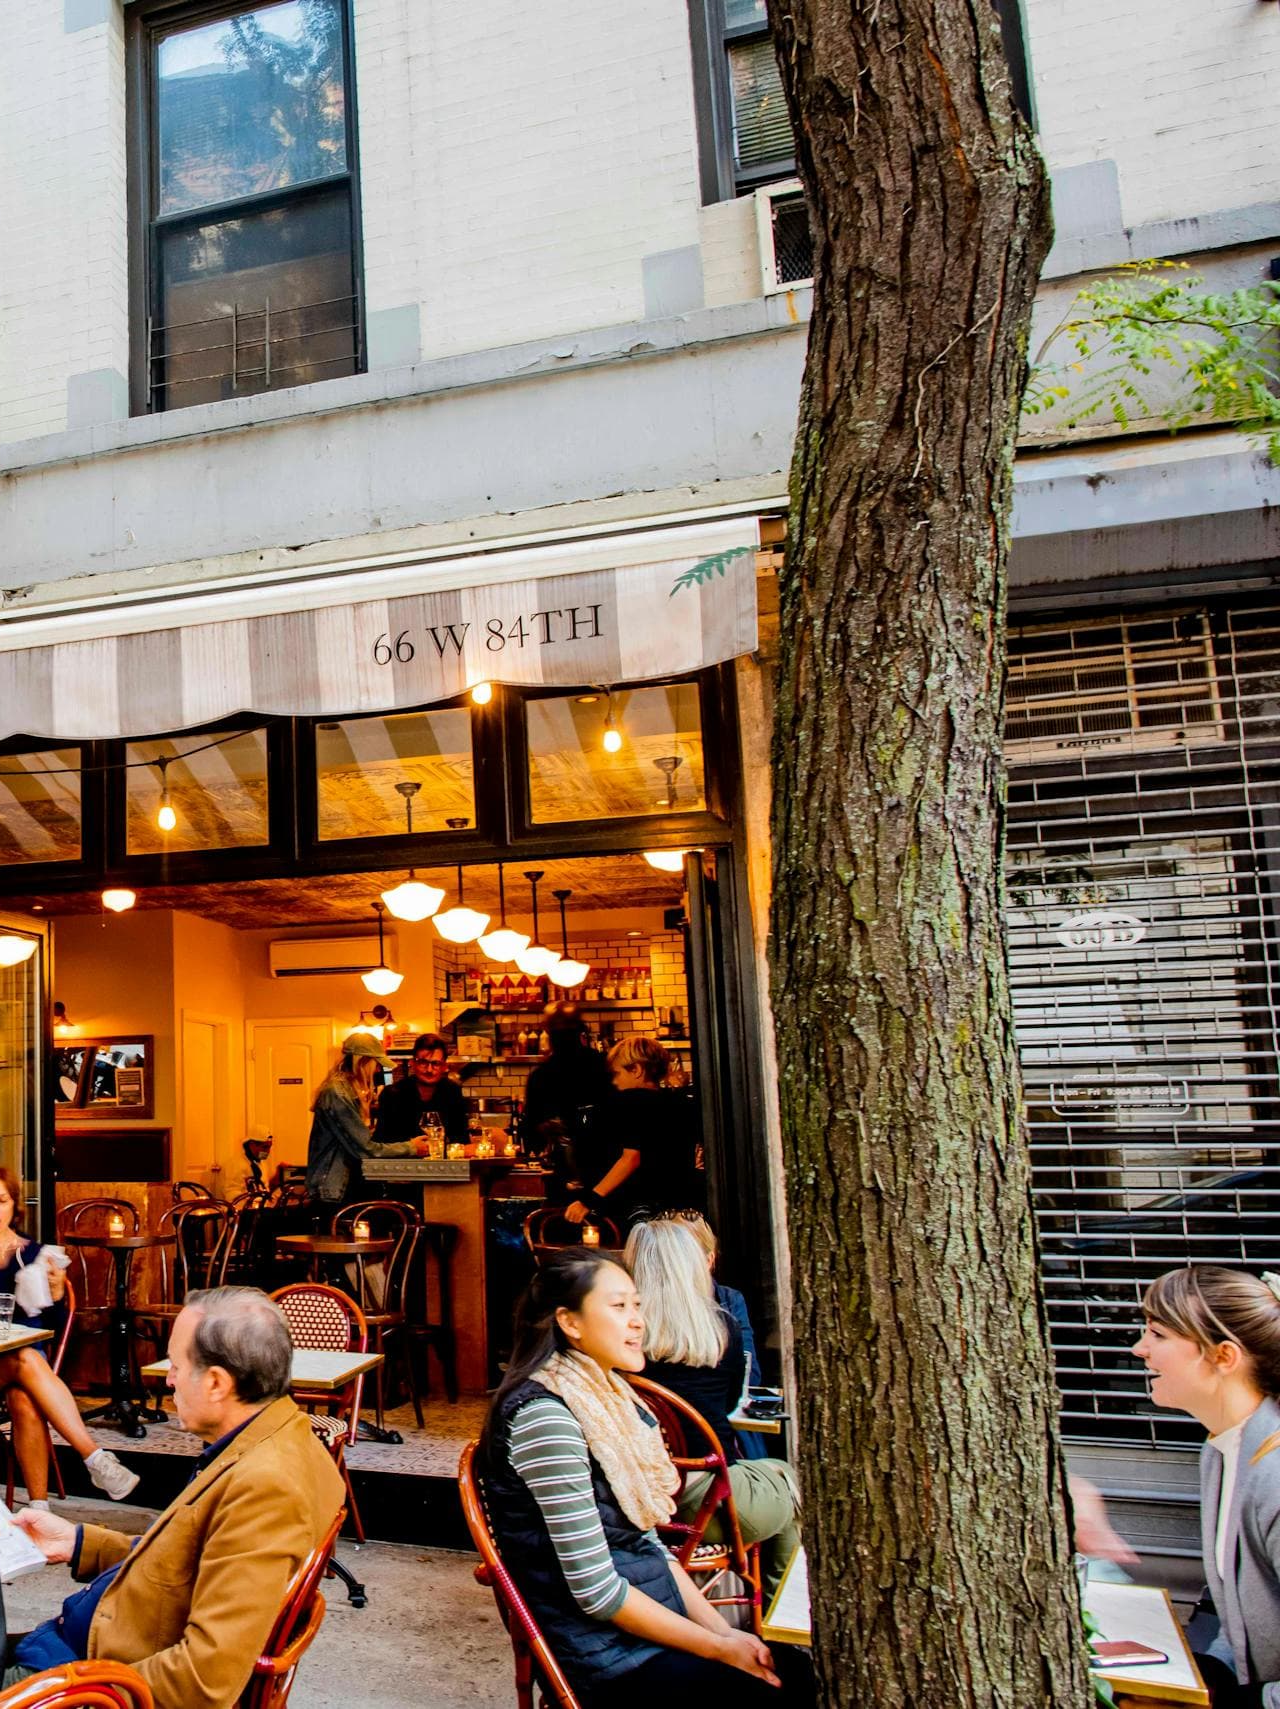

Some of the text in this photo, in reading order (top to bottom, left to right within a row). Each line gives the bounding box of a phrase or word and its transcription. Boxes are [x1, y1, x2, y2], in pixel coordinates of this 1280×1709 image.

[373, 604, 604, 665] 66 W 84TH
